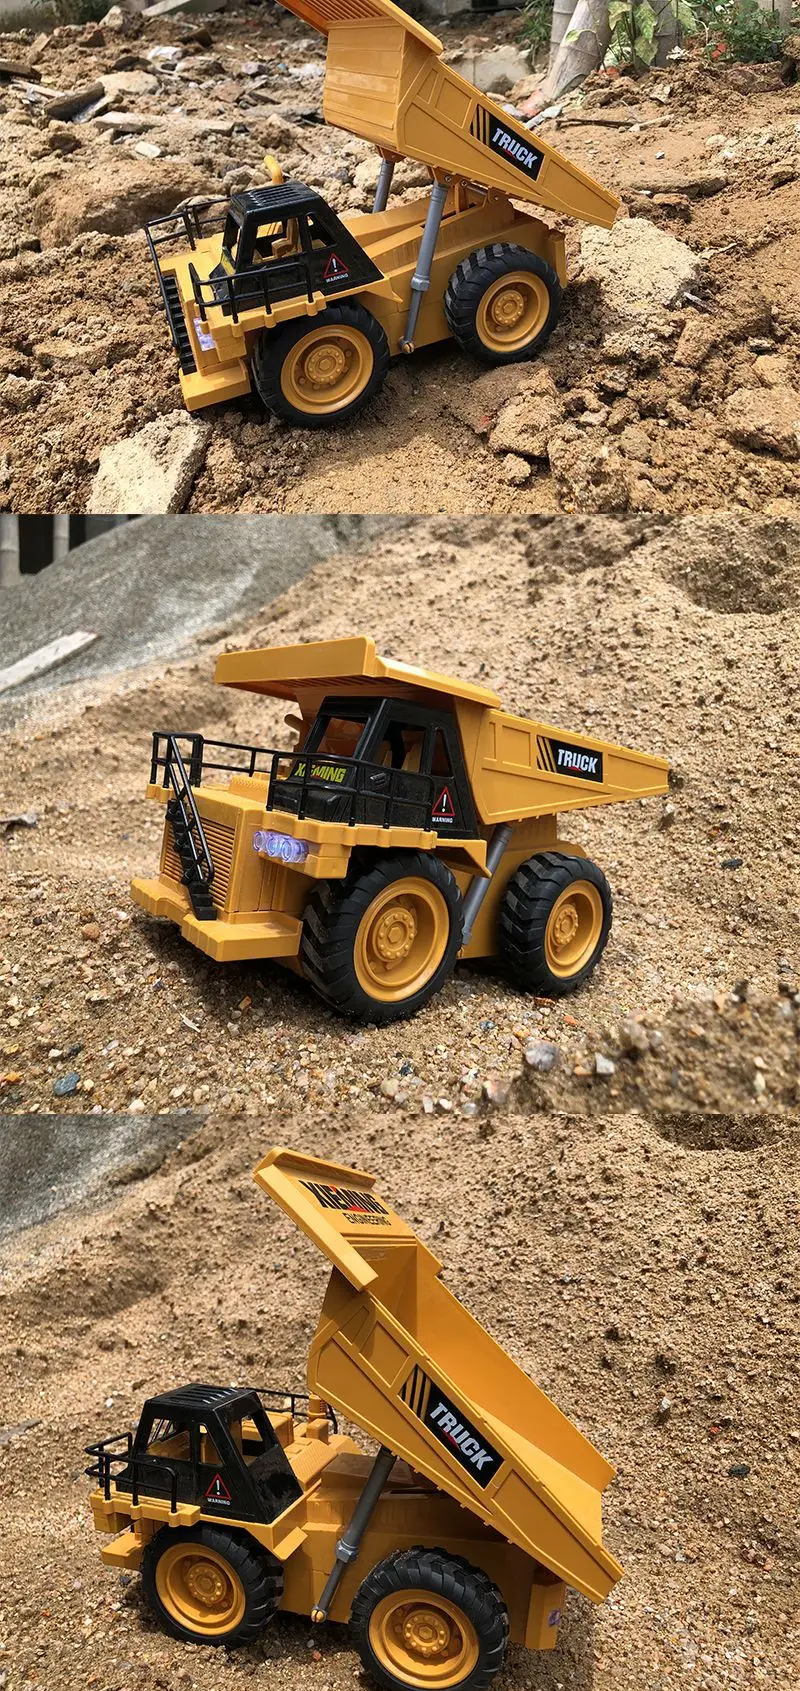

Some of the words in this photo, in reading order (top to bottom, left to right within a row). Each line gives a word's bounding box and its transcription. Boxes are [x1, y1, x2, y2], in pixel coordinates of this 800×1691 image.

[492, 128, 538, 169] TRUCK
[294, 763, 347, 783] XMING
[557, 748, 598, 774] TRUCK
[298, 1180, 389, 1215] XIEMING
[429, 1402, 494, 1471] TRUCK
